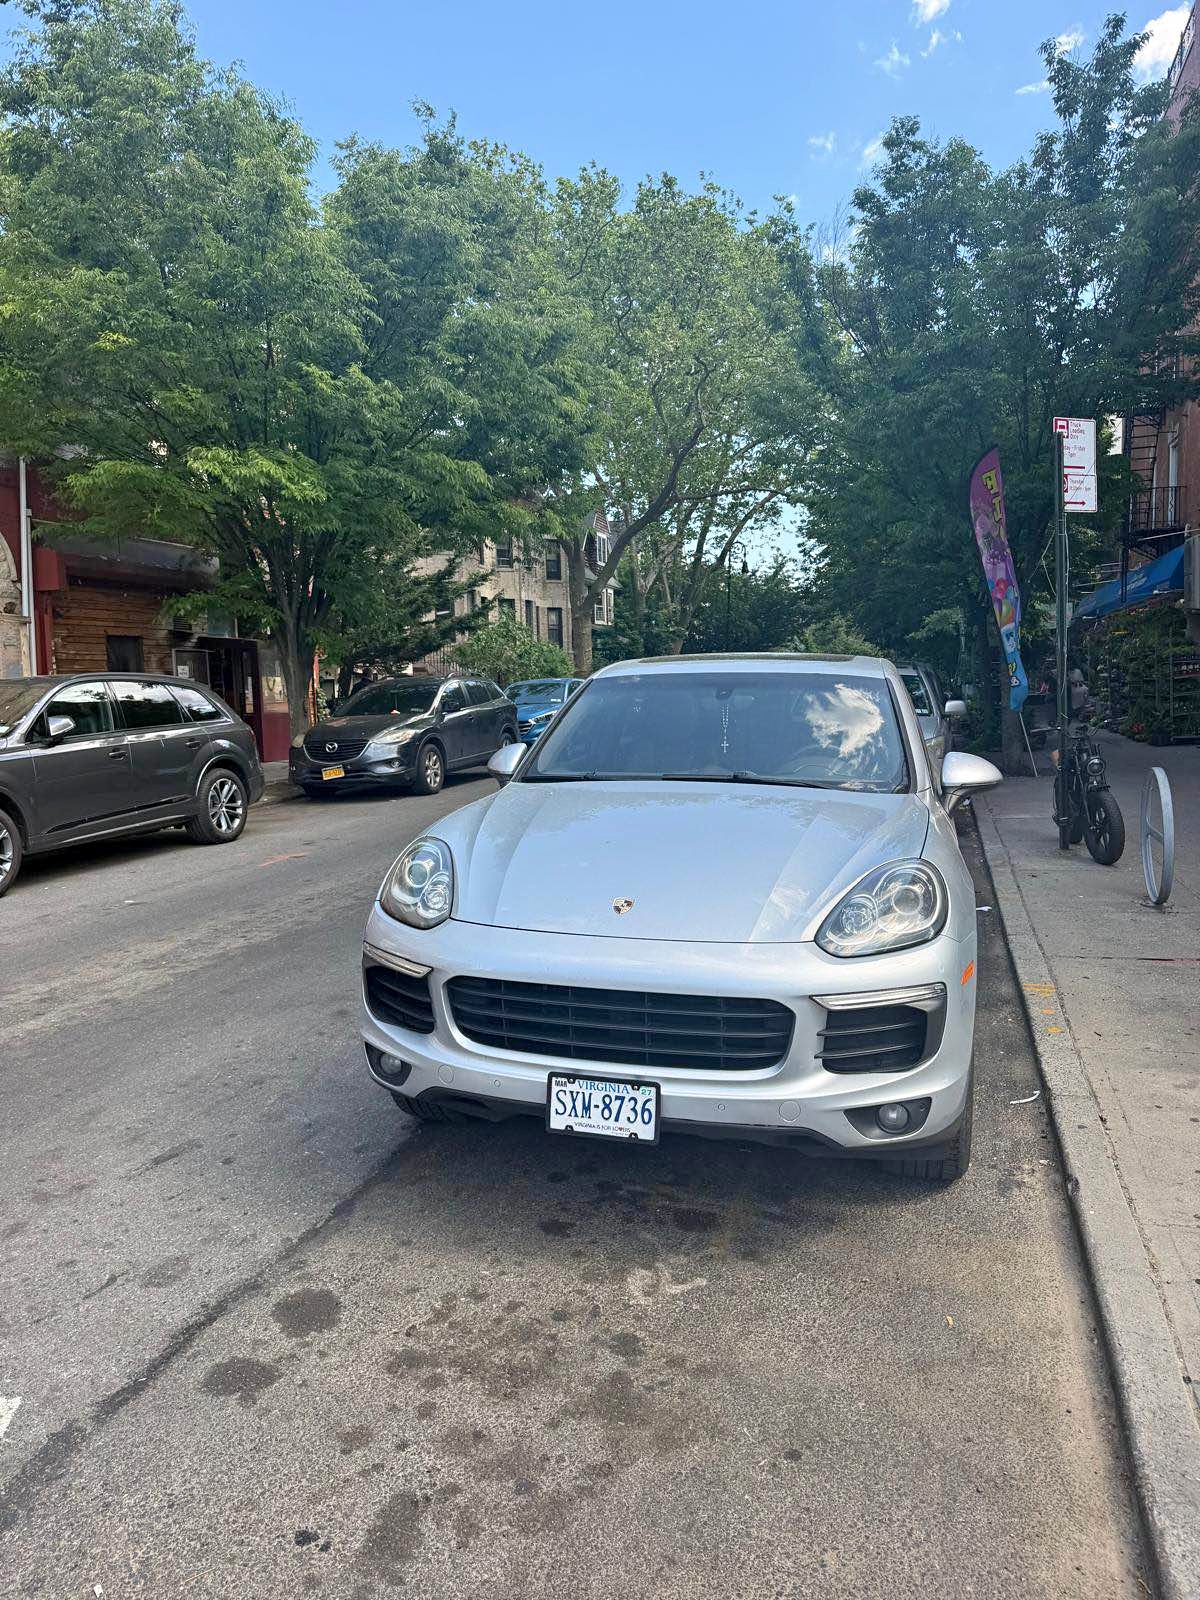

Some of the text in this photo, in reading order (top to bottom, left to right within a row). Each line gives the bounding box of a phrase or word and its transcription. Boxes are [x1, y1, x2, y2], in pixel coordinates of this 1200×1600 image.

[554, 1079, 568, 1088] MAR
[577, 1080, 630, 1095] VIRGINIA
[641, 1088, 652, 1096] 27
[555, 1089, 653, 1125] SXM-8736
[574, 1121, 595, 1130] VIRGINIA
